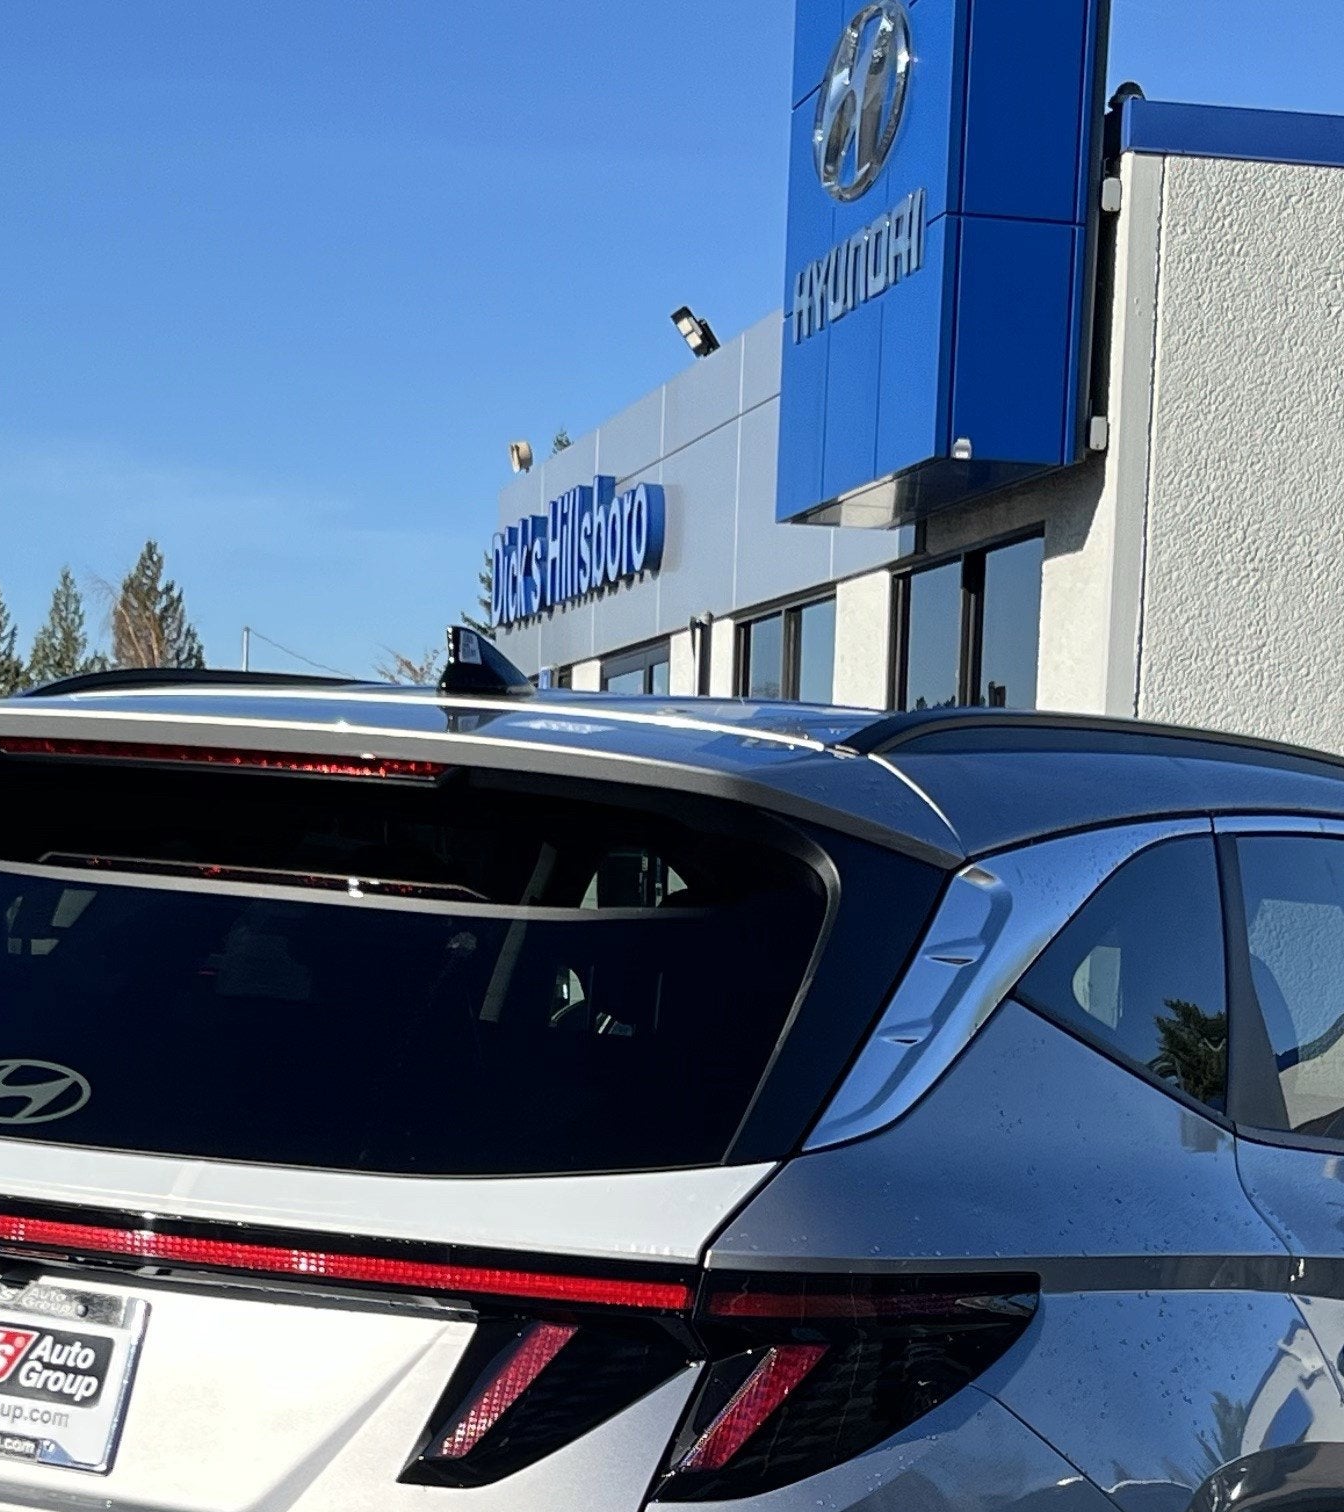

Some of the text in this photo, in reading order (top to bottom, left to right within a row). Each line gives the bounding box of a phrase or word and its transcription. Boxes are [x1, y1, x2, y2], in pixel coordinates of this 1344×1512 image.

[793, 187, 926, 345] HYUNDAI
[491, 474, 659, 628] Dick's Hillsboro
[29, 1286, 67, 1301] Auto
[29, 1335, 96, 1369] Auto
[19, 1360, 99, 1401] Group
